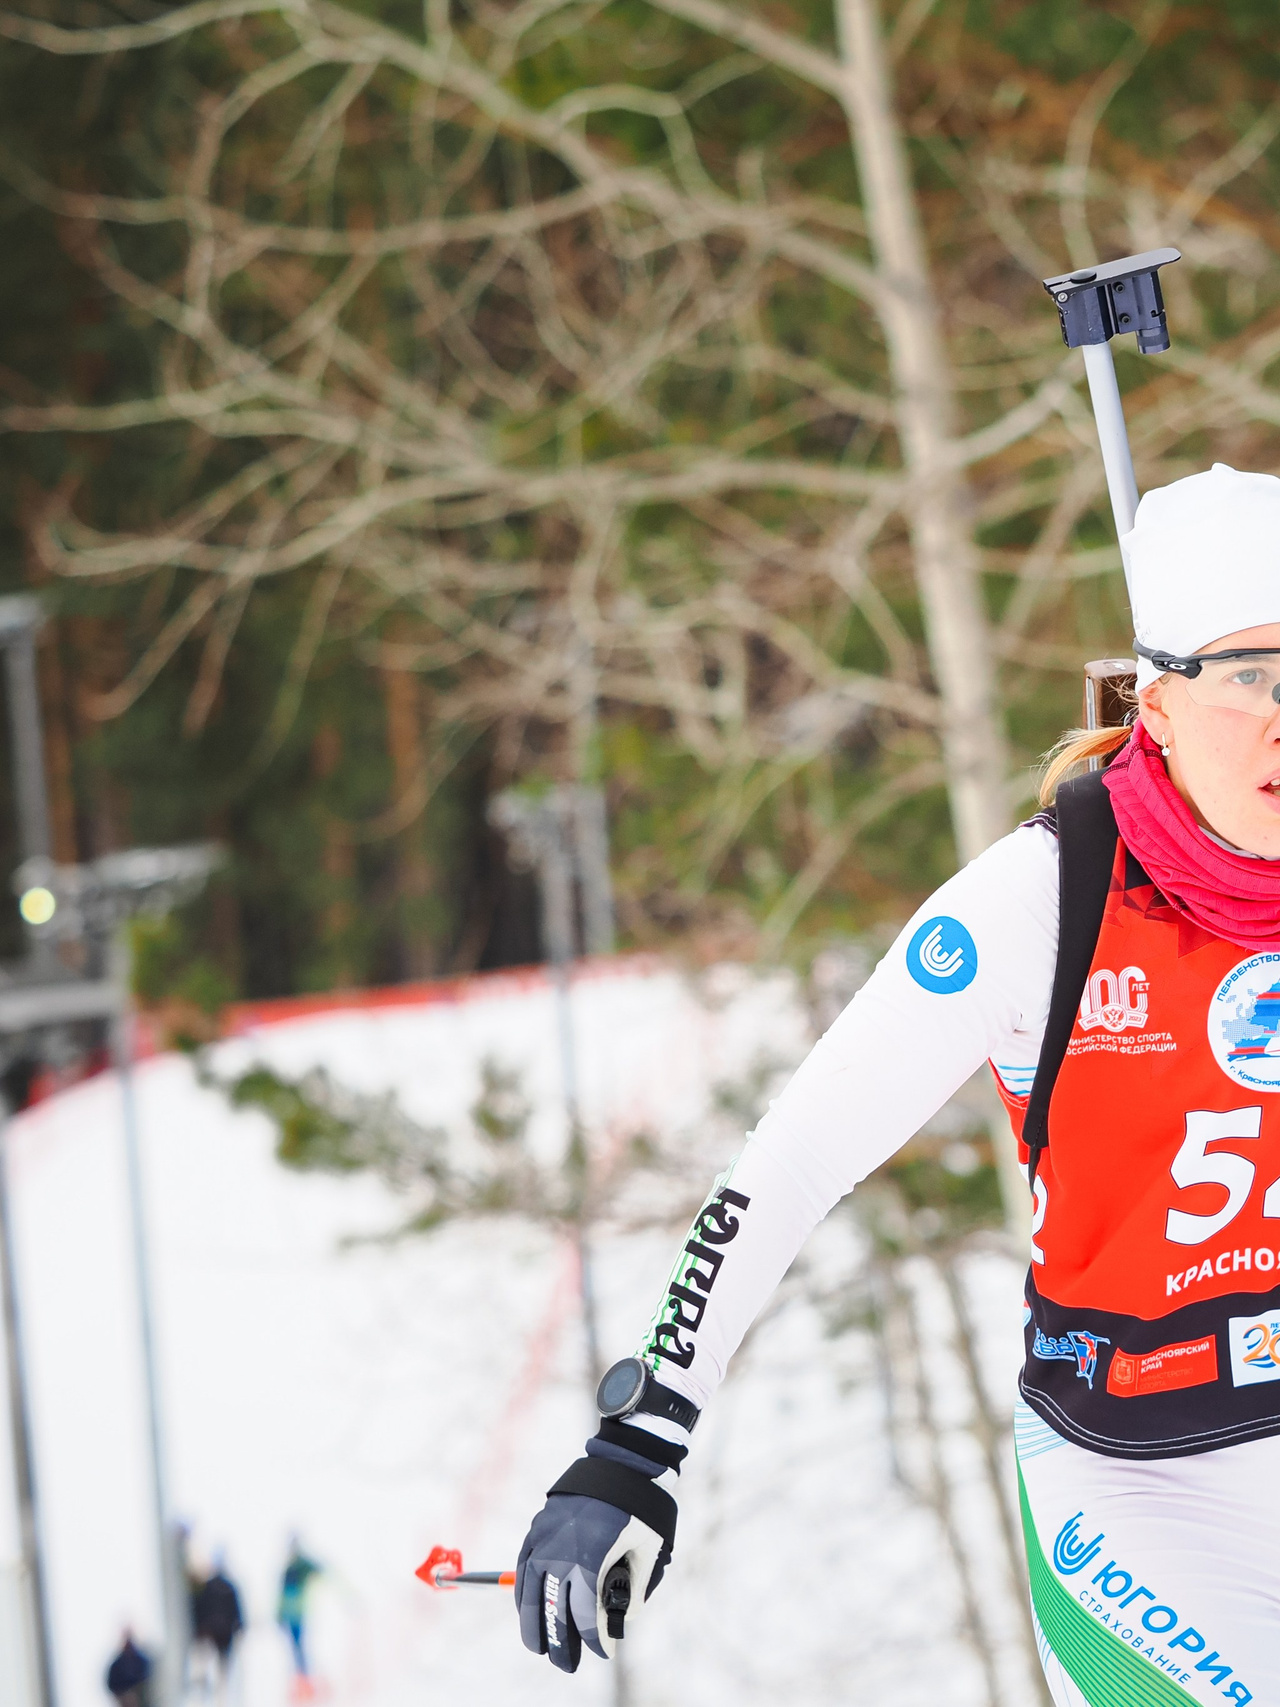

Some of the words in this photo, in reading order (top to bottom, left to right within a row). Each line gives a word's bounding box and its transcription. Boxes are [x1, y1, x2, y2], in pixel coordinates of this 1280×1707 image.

[1132, 982, 1150, 992] ЛЕТ
[1216, 954, 1280, 1002] ПЕРВЕНСТВО
[1066, 1042, 1118, 1056] ОССИЙСКОЙ
[1119, 1042, 1177, 1055] ФЕДЕРАЦИИ
[1137, 1032, 1173, 1043] СПОРТА
[1024, 1168, 1049, 1266] 2
[648, 1187, 751, 1369] ЮГРА
[1140, 1359, 1163, 1374] КРАЙ
[1141, 1340, 1210, 1366] КРАСНОЯРСКИЙ
[1079, 1590, 1192, 1684] СТРАХОВАНИЕ
[1091, 1560, 1254, 1707] ЮГОРИЯ
